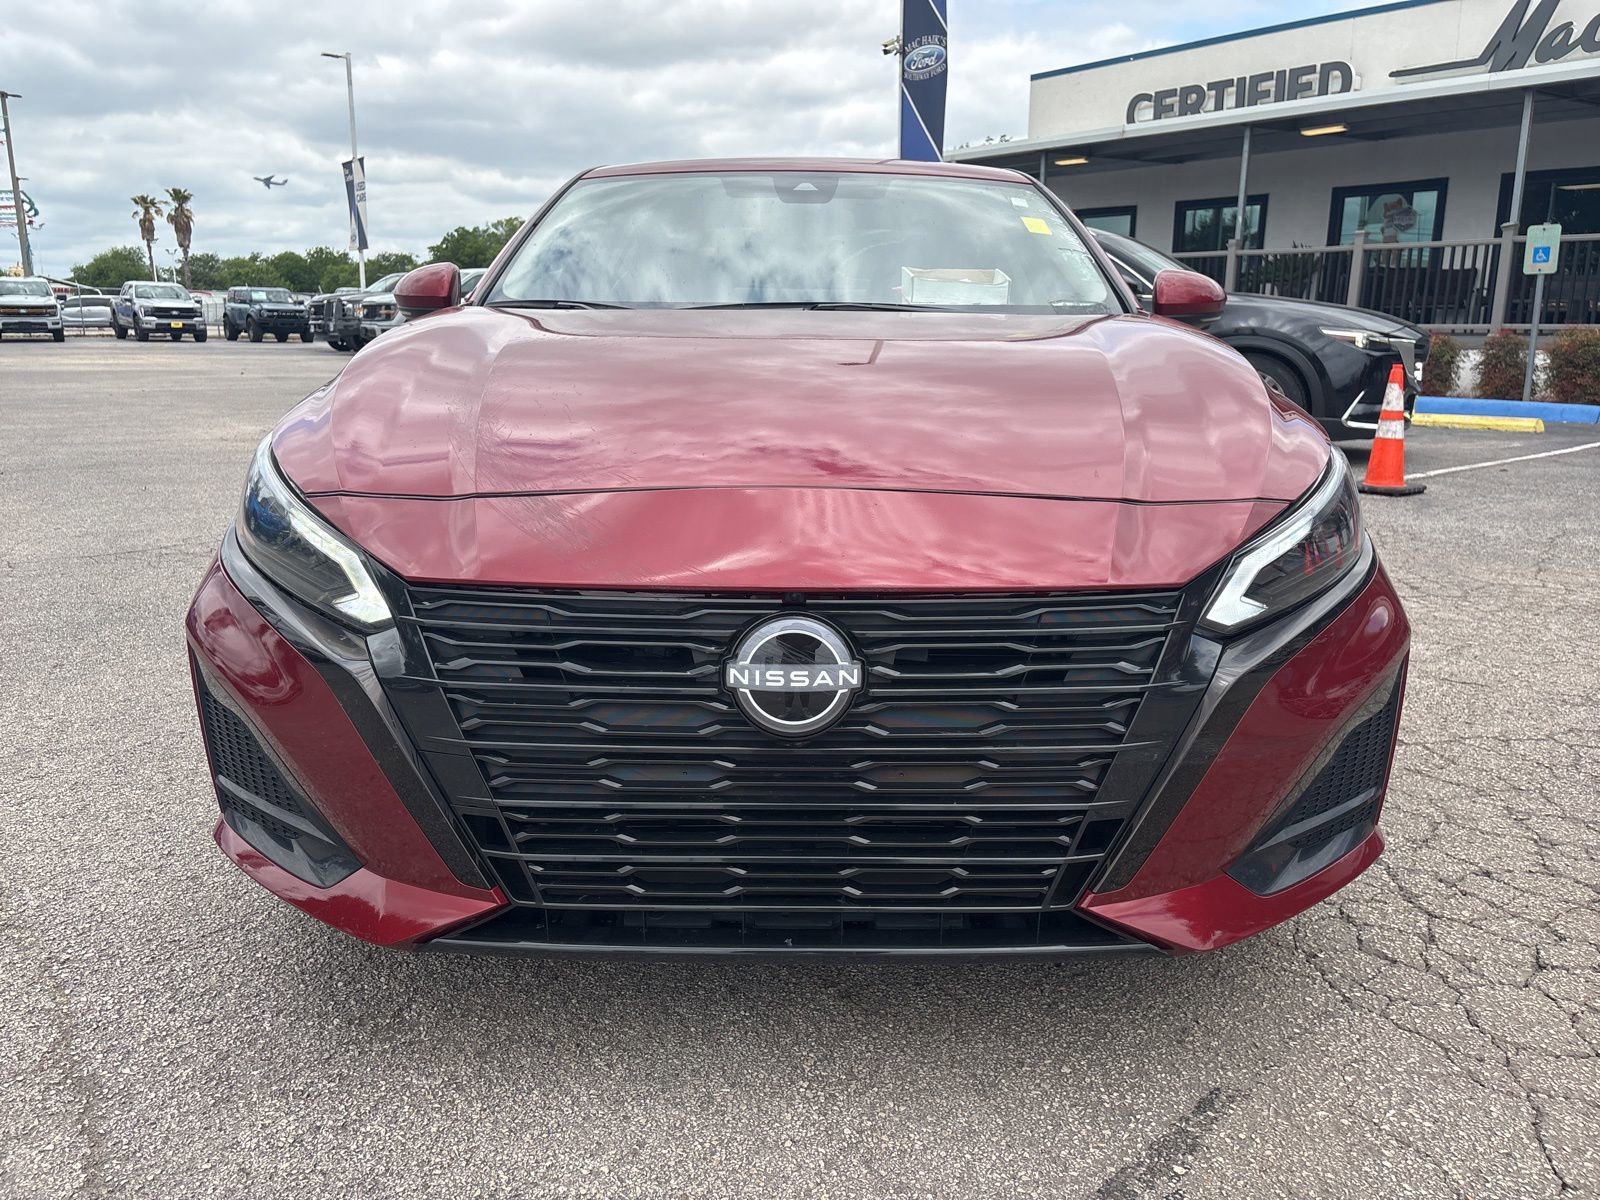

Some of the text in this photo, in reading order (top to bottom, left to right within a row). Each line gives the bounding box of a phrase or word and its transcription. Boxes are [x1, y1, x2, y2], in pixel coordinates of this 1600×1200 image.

[904, 37, 920, 53] MAC
[911, 50, 937, 69] Ford
[930, 63, 946, 77] FORD
[1126, 61, 1353, 124] CERTIFIED
[729, 668, 858, 687] NISSAN
